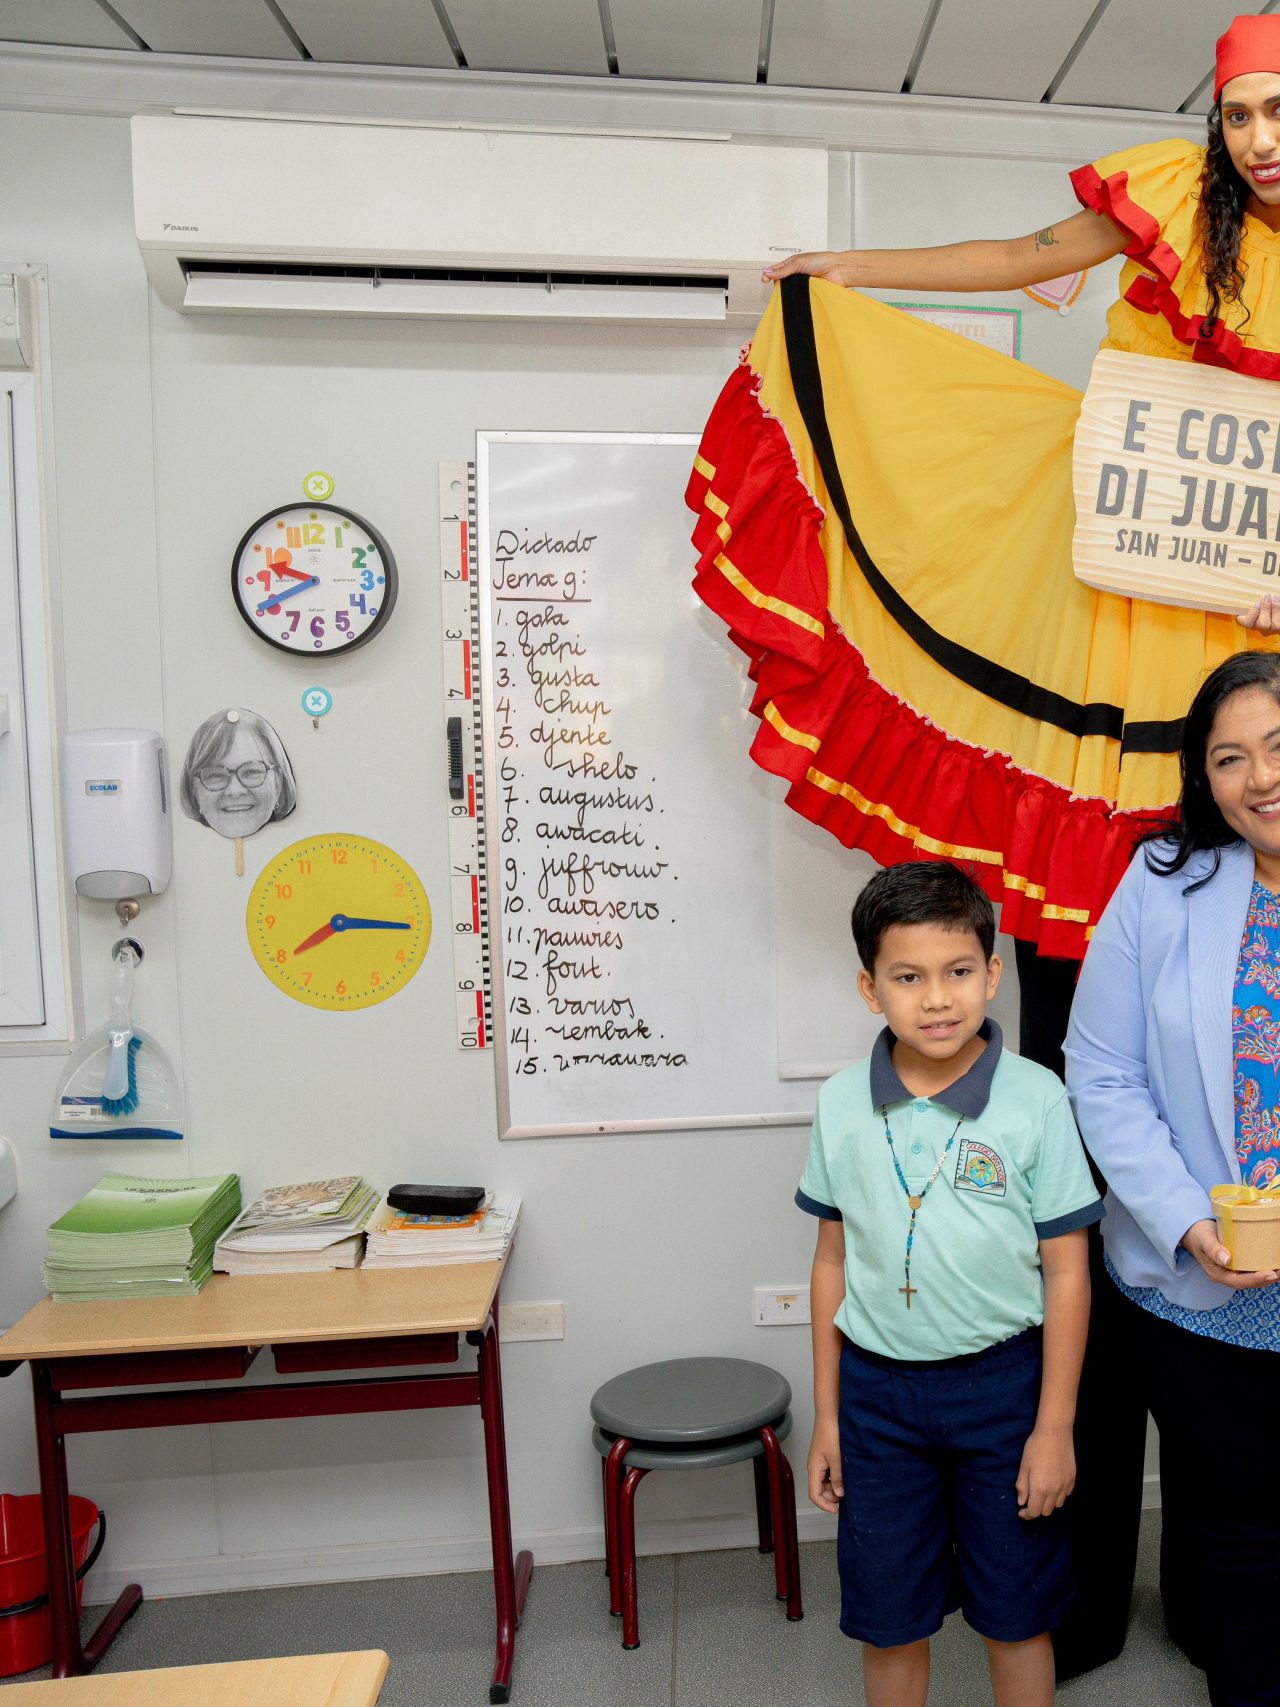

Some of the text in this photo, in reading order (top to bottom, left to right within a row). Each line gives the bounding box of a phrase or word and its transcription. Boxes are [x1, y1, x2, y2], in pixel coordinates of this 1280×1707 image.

[1123, 399, 1152, 453] E
[1095, 463, 1149, 520] DI
[302, 522, 326, 545] 12
[496, 528, 598, 555] Dictado
[1114, 528, 1160, 558] SAN
[1167, 535, 1228, 568] JUAN
[351, 547, 367, 569] 2
[256, 569, 271, 592] 9
[360, 569, 375, 591] 3
[444, 569, 461, 580] 2
[349, 593, 367, 615] 4
[285, 610, 301, 633] 7
[310, 616, 326, 638] 6
[335, 610, 351, 633] 5
[446, 629, 463, 639] 3
[495, 641, 515, 658] 2.
[447, 688, 464, 698] 4
[496, 665, 600, 708] 3. gusta
[496, 696, 516, 724] 4.
[497, 718, 612, 768] 5. djente
[500, 756, 524, 781] 6.
[89, 784, 118, 792] ECOLAB
[502, 785, 529, 814] 7.
[501, 817, 521, 843] 8.
[331, 849, 348, 865] 12
[370, 859, 378, 874] 1
[298, 859, 312, 875] 11
[453, 864, 470, 874] 7
[275, 884, 293, 900] 10
[394, 882, 405, 898] 2
[504, 895, 531, 913] 10.
[265, 915, 276, 930] 9
[456, 923, 473, 933] 8
[277, 949, 287, 964] 8
[395, 949, 406, 963] 4
[370, 971, 381, 986] 5
[506, 958, 539, 981] 12.
[302, 972, 313, 987] 7
[336, 980, 346, 995] 6
[509, 996, 540, 1015] 13.
[461, 1031, 478, 1048] 10
[510, 1026, 537, 1054] 14.
[515, 1055, 547, 1075] 15.
